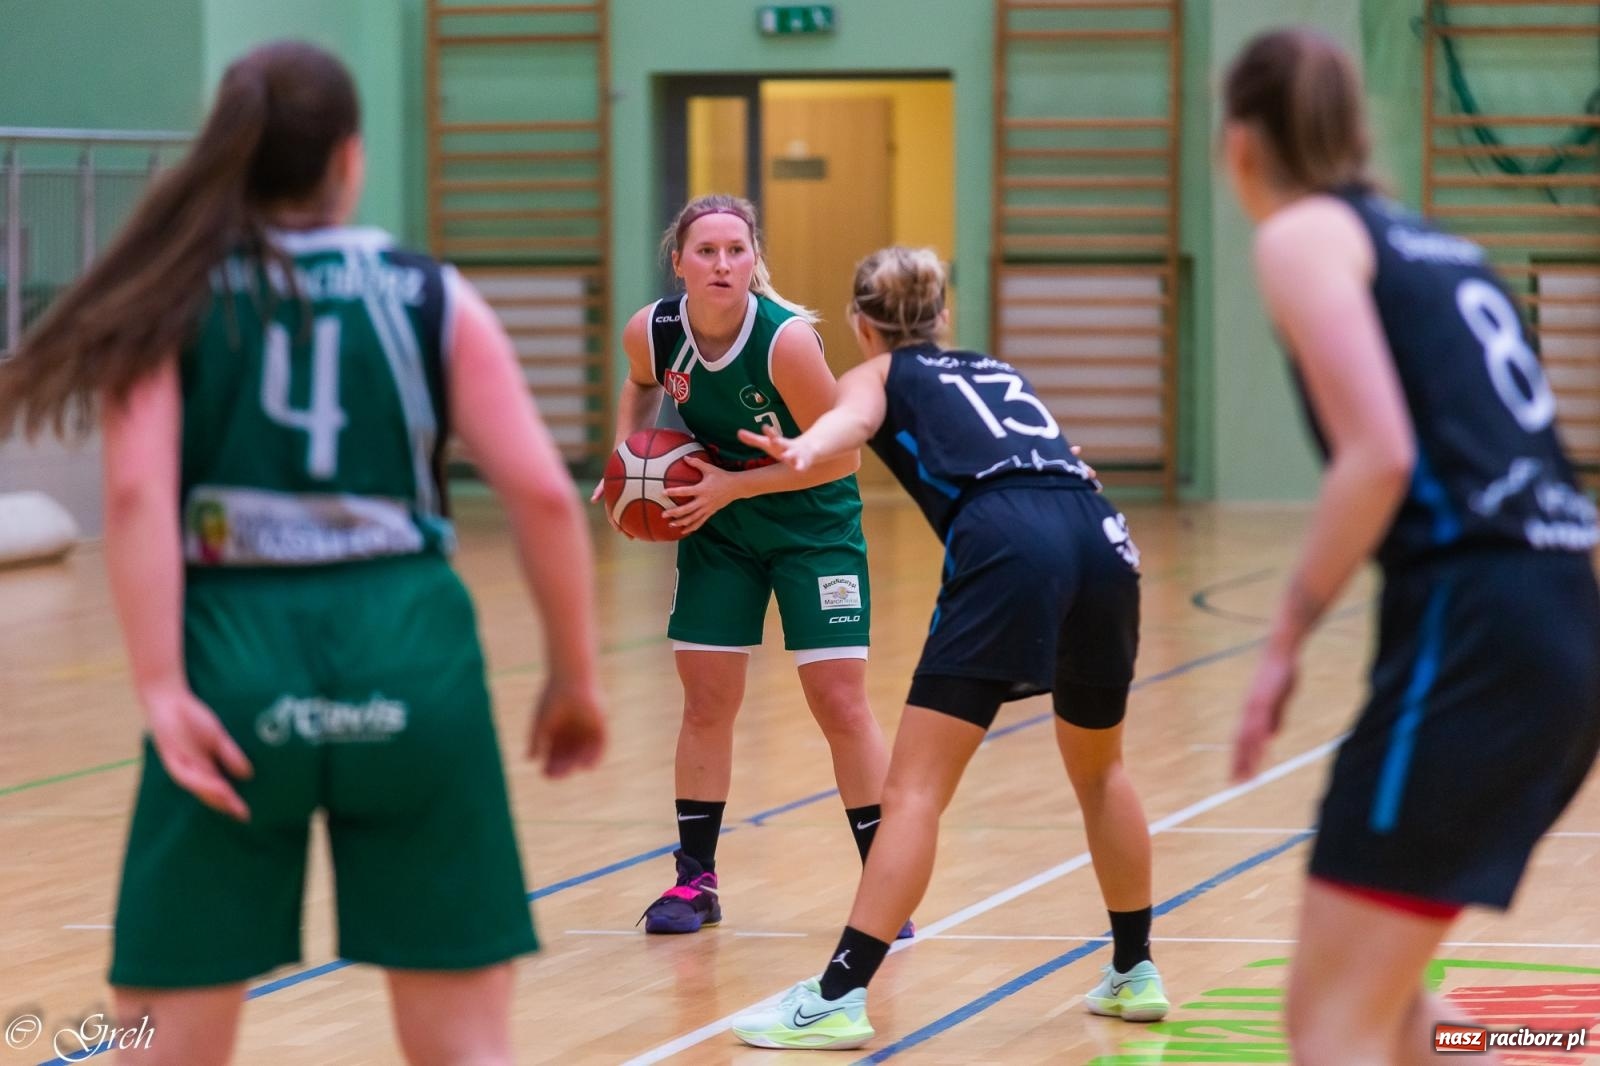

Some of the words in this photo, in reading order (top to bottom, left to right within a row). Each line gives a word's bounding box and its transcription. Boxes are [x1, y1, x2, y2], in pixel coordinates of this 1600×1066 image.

[261, 315, 348, 480] 4
[938, 373, 1060, 440] 13
[1455, 278, 1555, 433] 8
[829, 615, 860, 624] COLO
